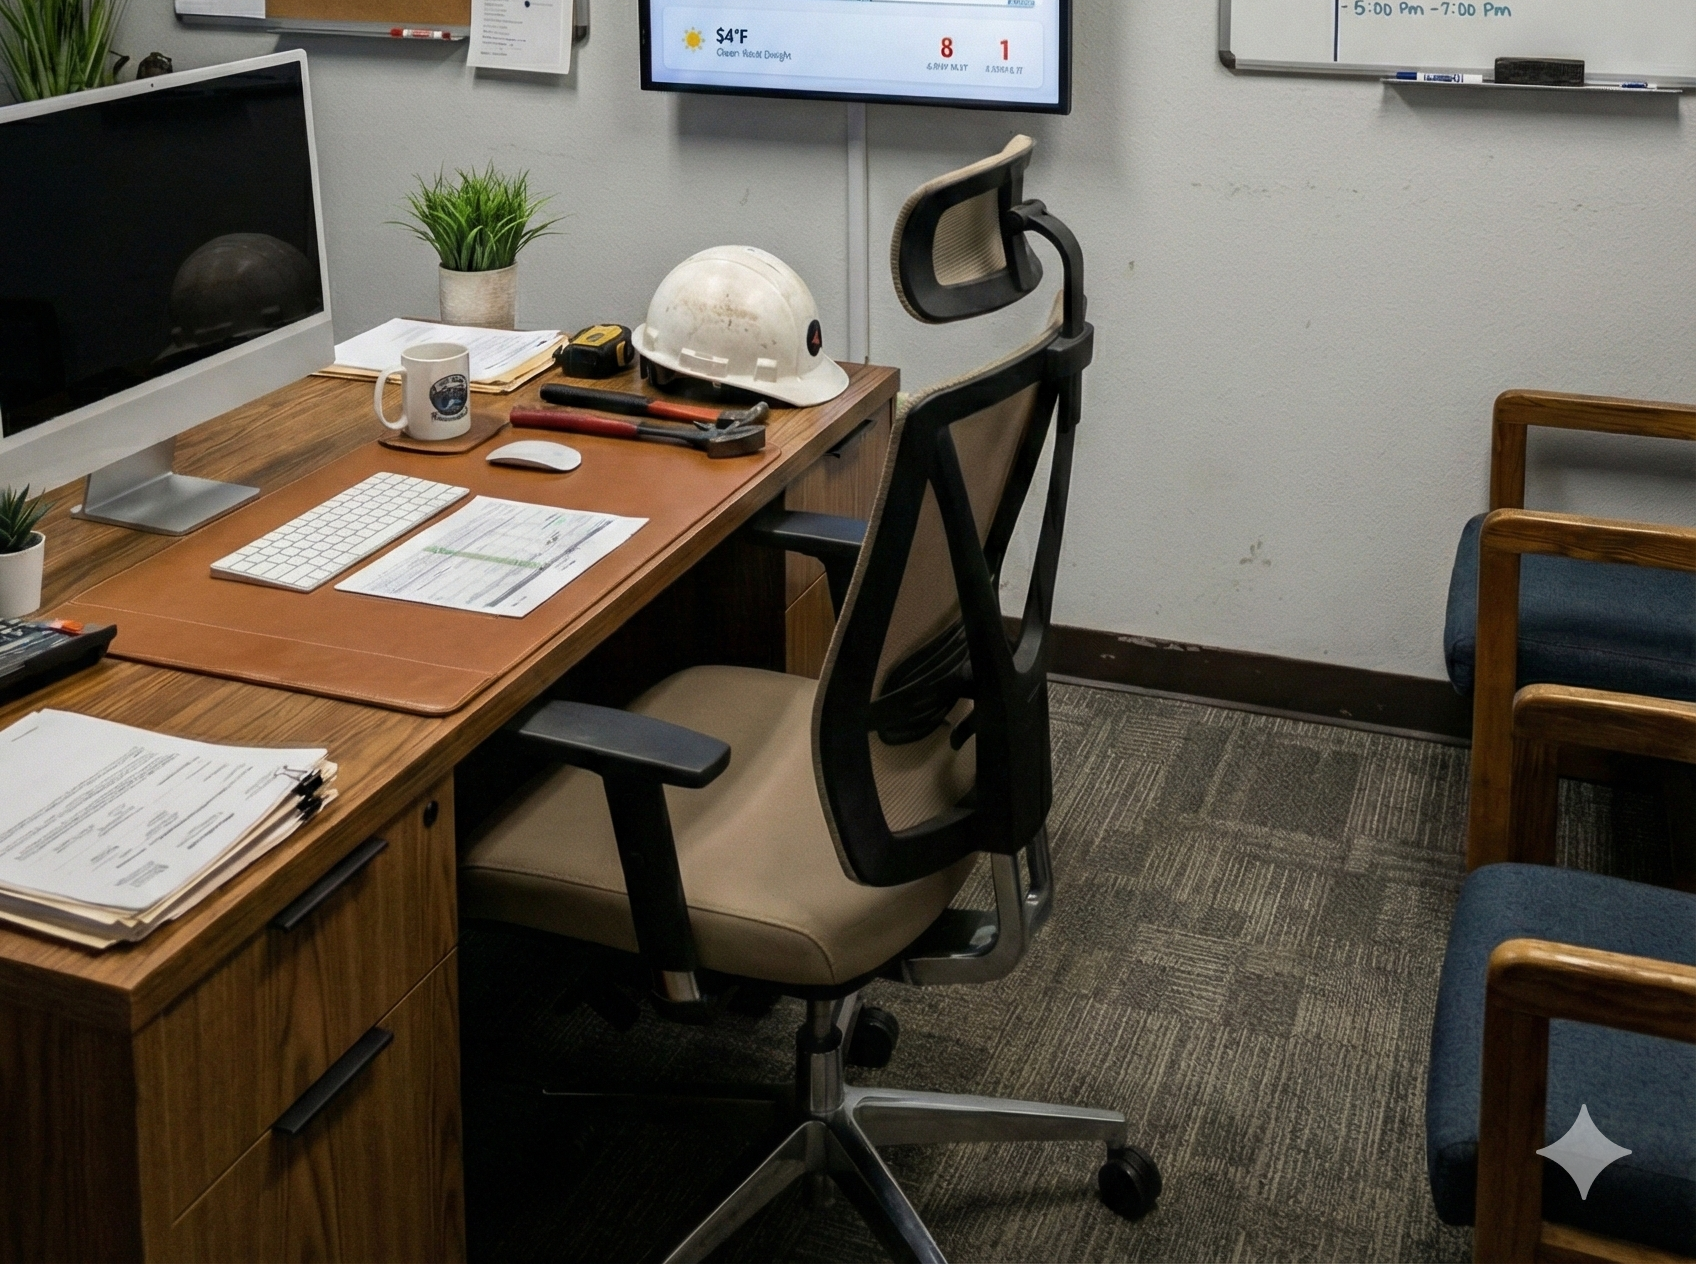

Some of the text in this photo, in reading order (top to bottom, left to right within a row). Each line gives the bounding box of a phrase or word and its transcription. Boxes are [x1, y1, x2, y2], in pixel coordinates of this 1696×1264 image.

[1354, 0, 1392, 16] 5:00
[941, 37, 953, 58] 8
[1000, 39, 1009, 61] 1
